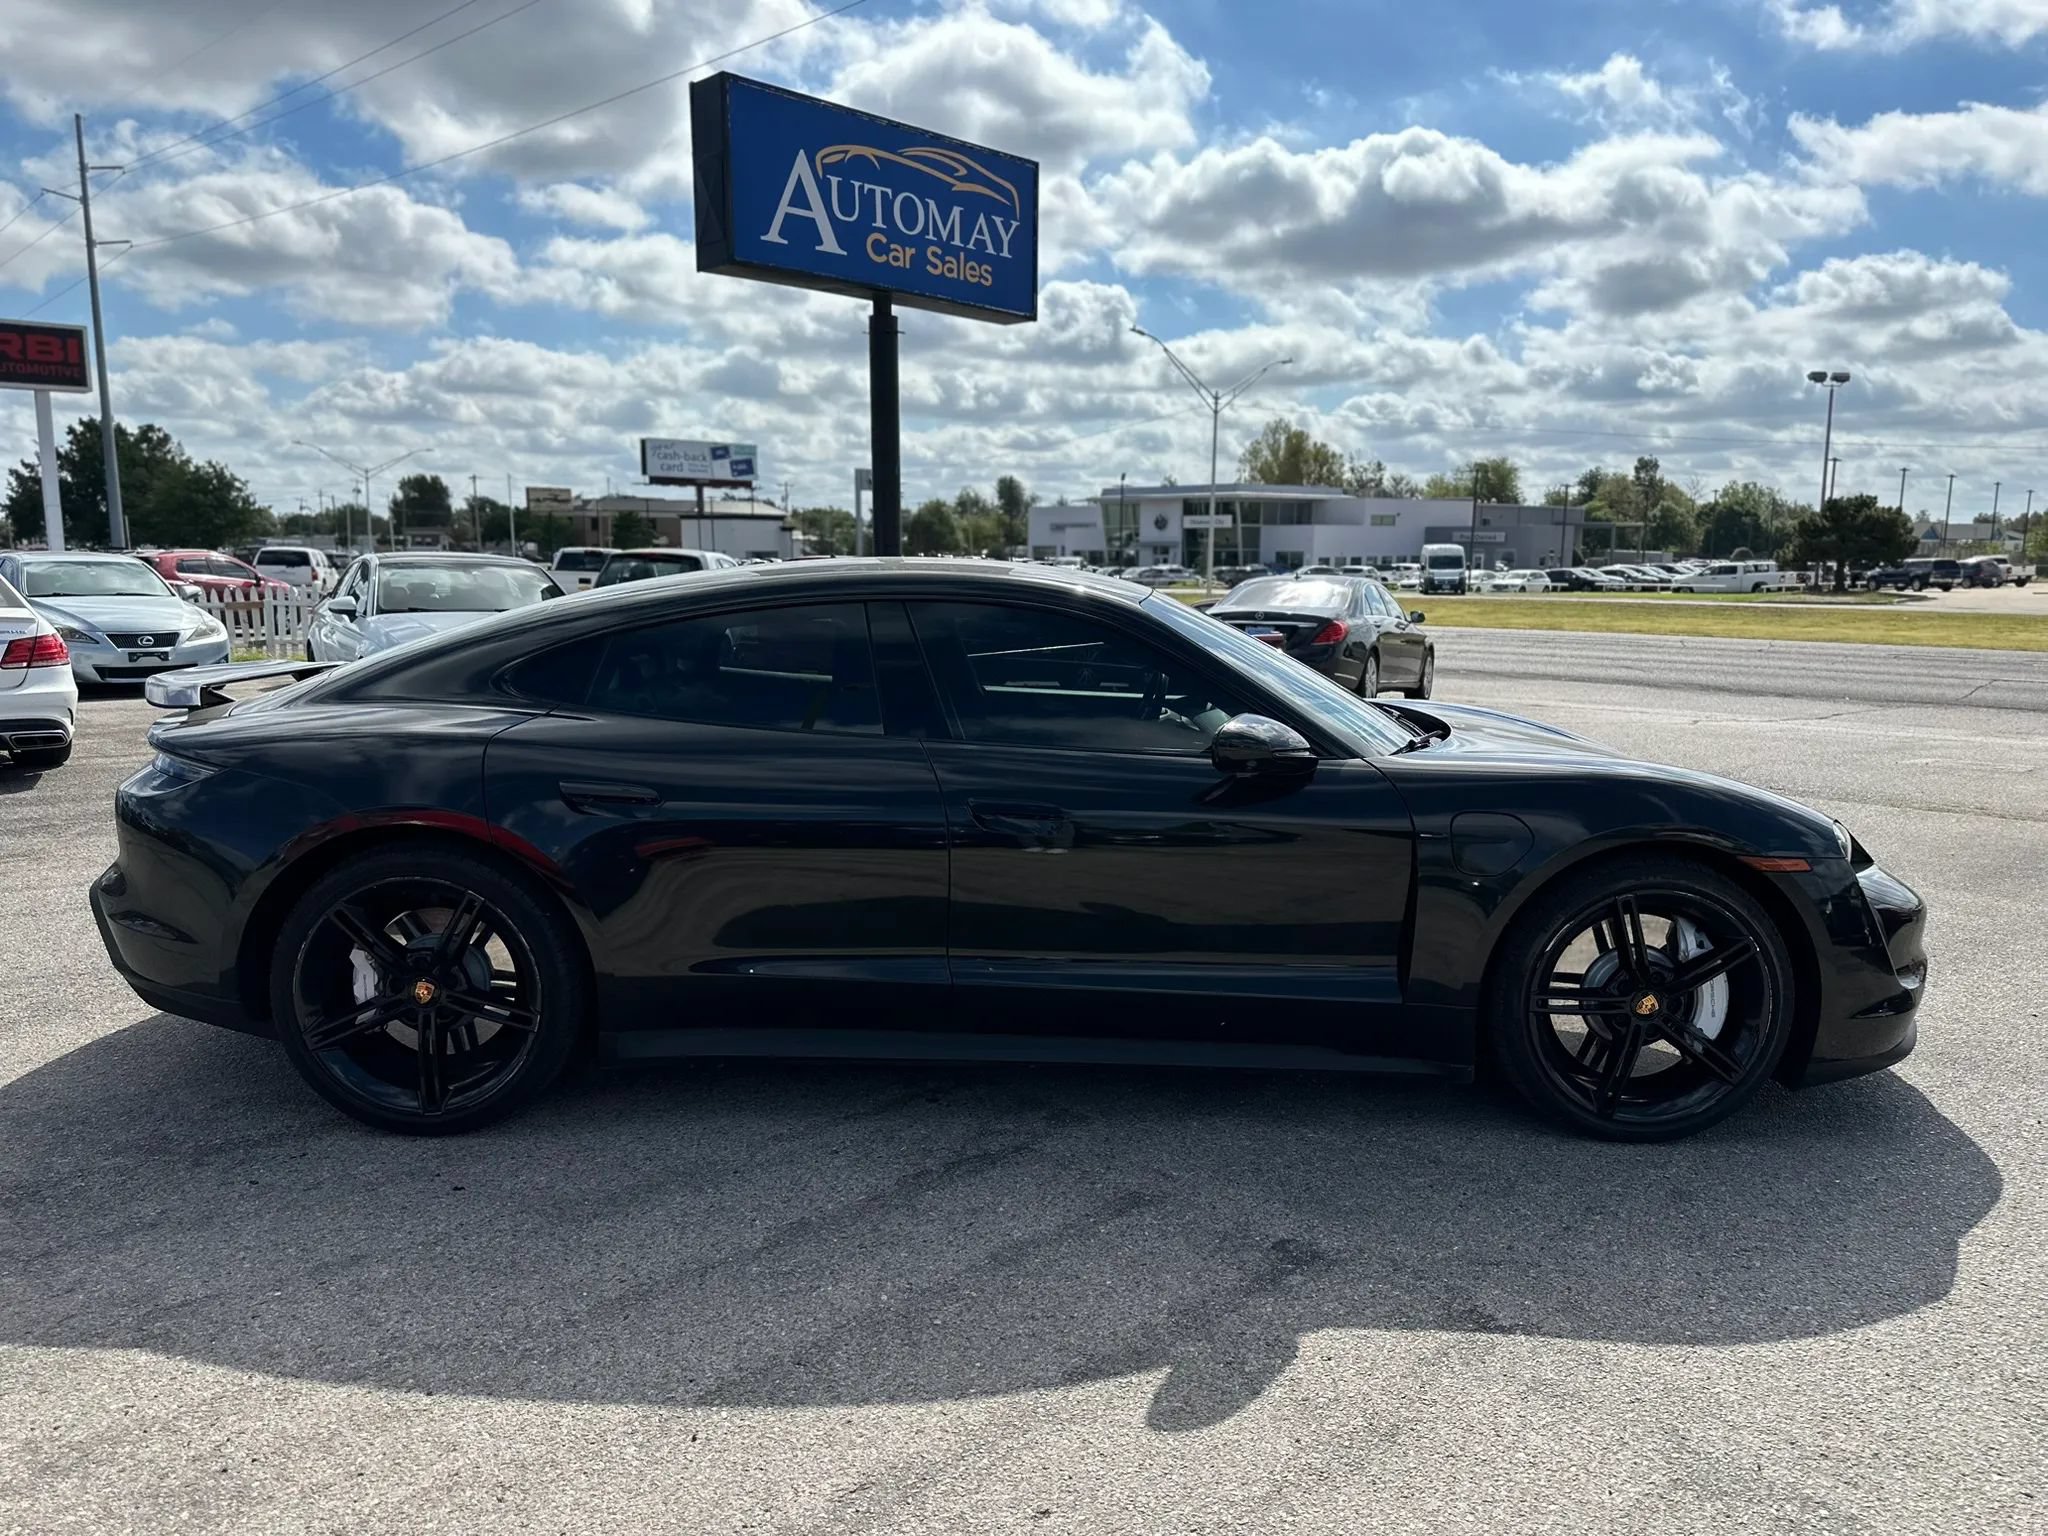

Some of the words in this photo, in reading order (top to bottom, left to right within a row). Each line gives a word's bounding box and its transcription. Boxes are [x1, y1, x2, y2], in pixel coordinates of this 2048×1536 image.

[760, 149, 1020, 258] AUTOMAY
[866, 233, 916, 269] Car
[926, 246, 993, 286] Sales
[0, 362, 80, 377] UTOMOTIVE
[657, 450, 707, 462] cash-back
[660, 462, 684, 472] card
